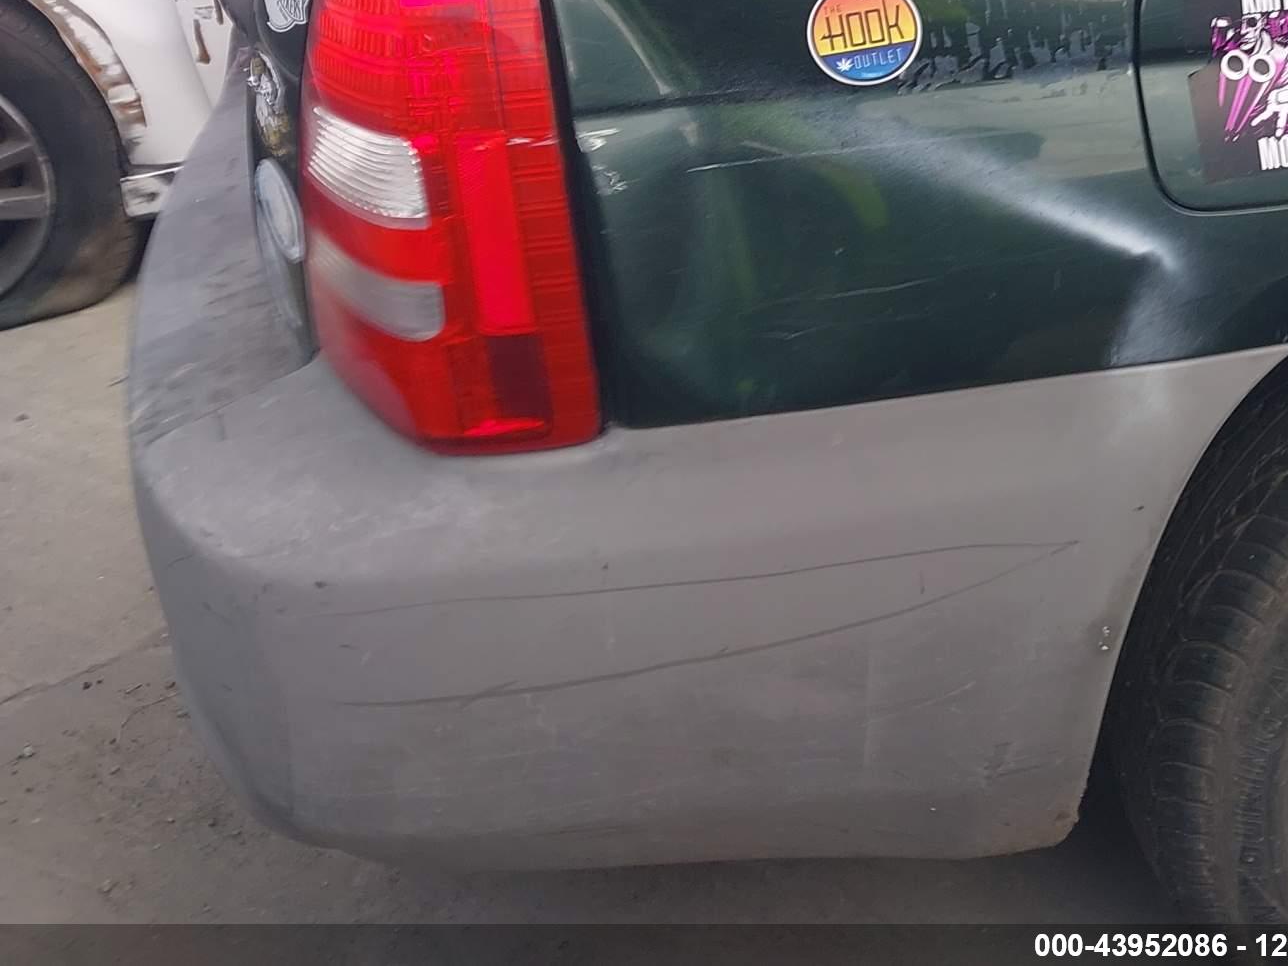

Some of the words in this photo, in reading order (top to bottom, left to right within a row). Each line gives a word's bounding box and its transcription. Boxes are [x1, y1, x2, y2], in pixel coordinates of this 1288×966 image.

[823, 4, 842, 15] THE
[820, 4, 905, 51] HOOK
[853, 48, 904, 69] OUTLET
